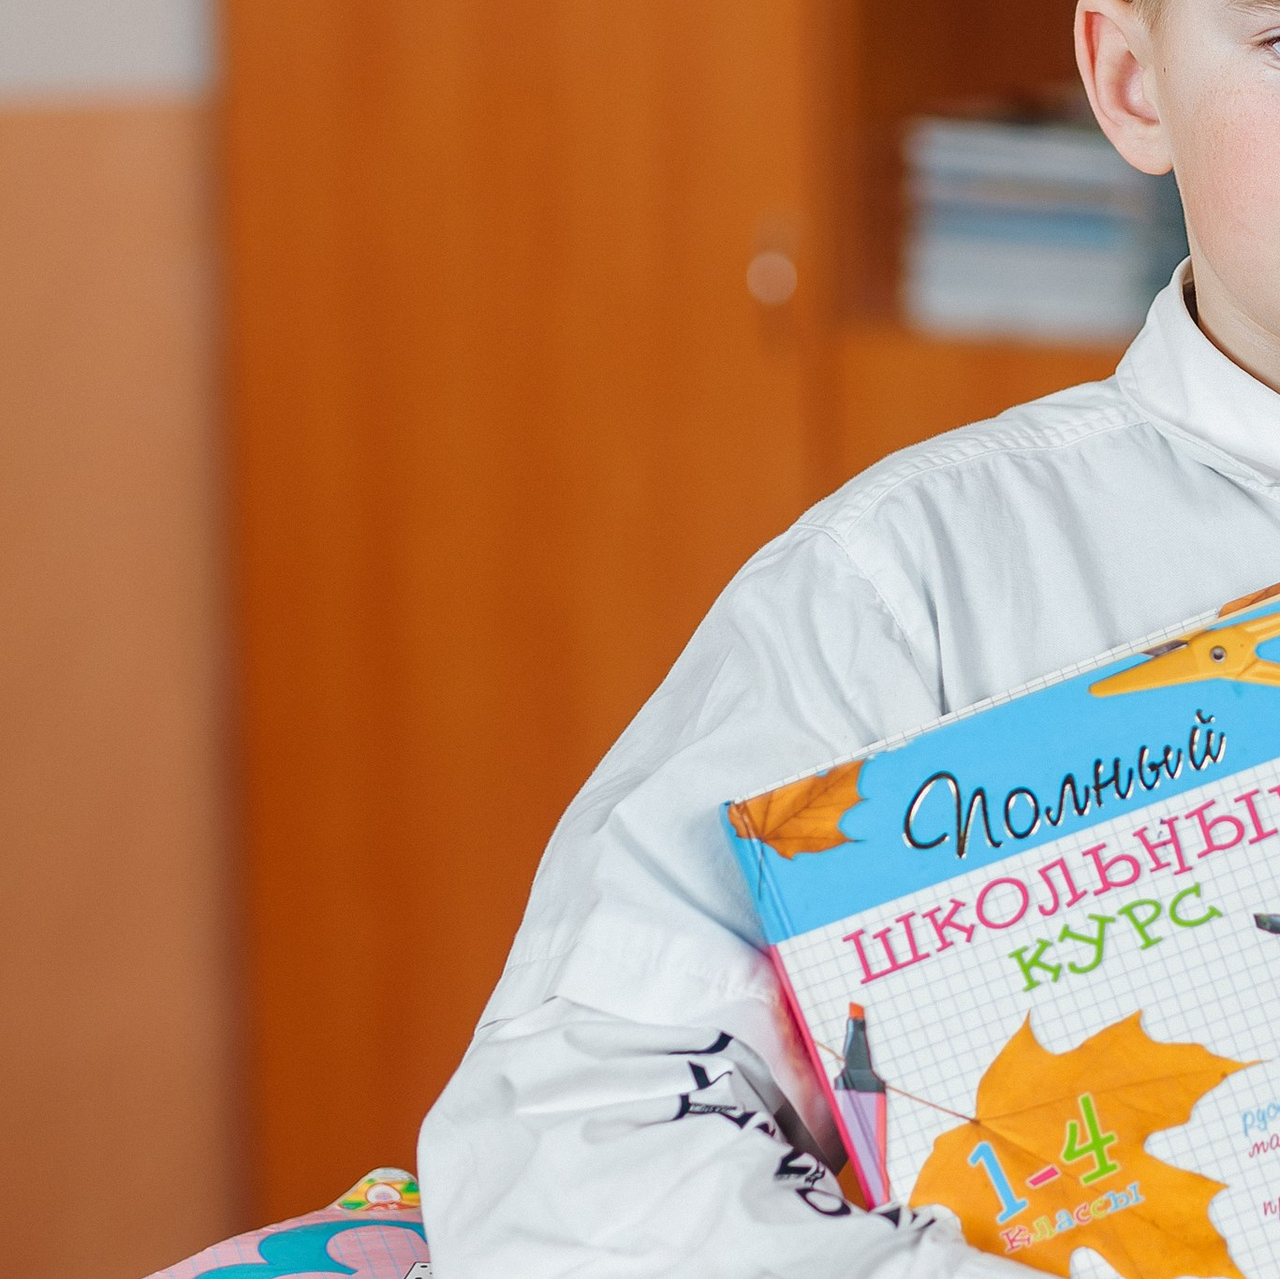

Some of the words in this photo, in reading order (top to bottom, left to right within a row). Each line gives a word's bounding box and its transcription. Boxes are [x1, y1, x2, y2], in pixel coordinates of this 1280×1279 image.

[901, 708, 1227, 859] Полный
[1008, 882, 1222, 992] КУРС
[967, 1092, 1121, 1224] 1-4
